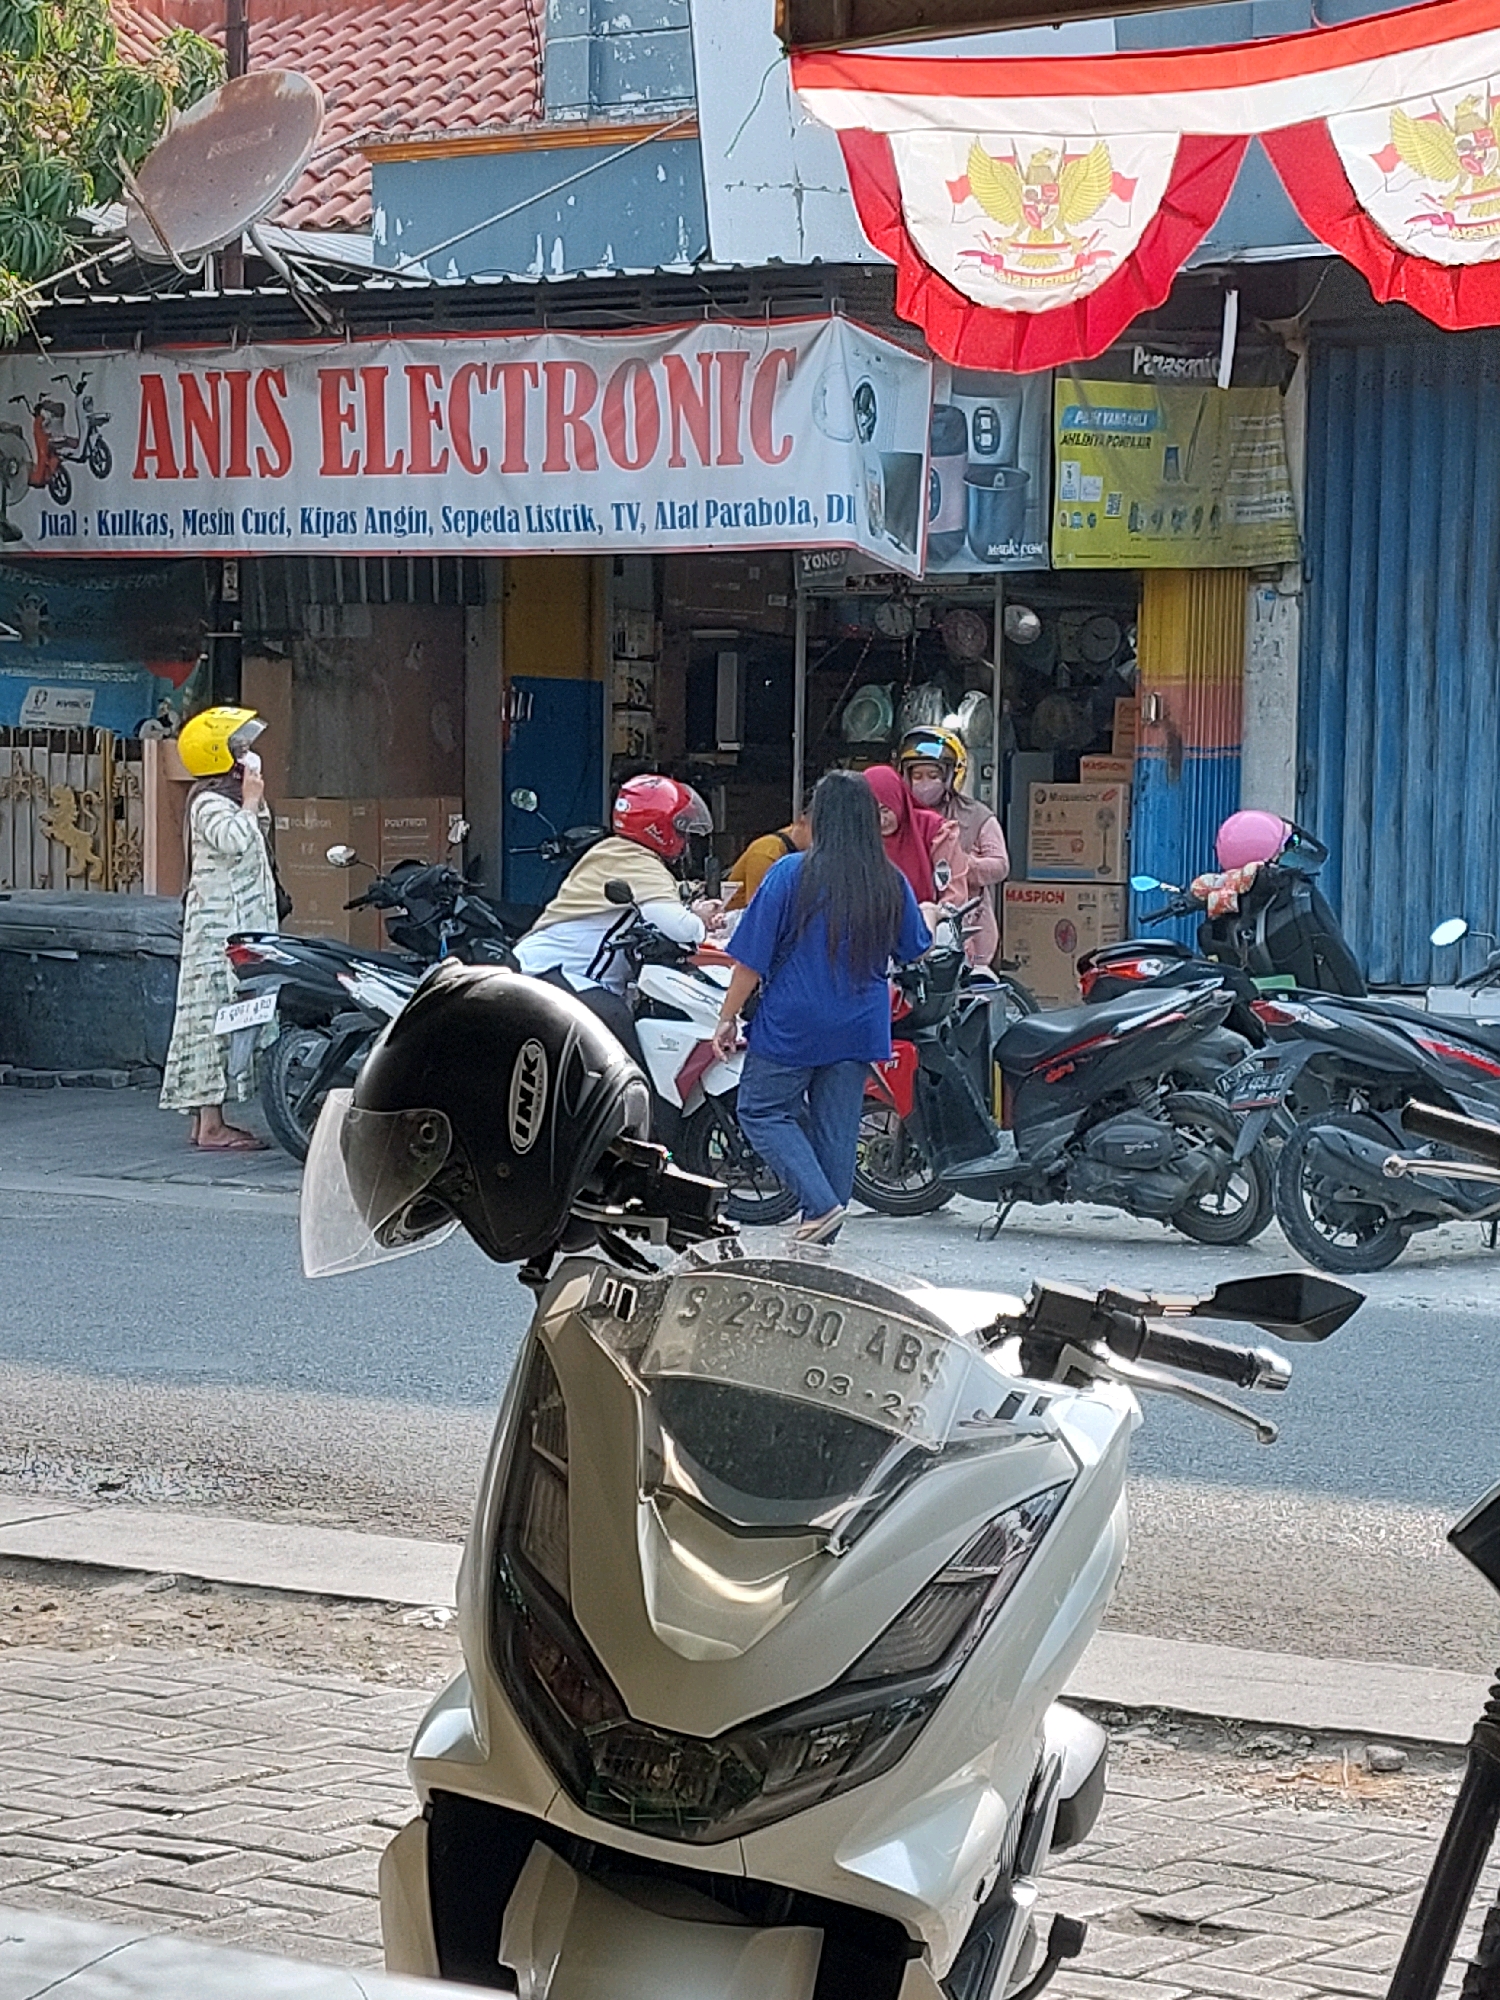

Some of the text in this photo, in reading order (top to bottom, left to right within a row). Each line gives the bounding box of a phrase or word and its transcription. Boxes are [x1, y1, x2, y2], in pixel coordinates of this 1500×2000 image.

[132, 346, 798, 480] ANIS ELECTRONIC
[38, 509, 78, 541] Jual
[96, 508, 175, 540] Kulkas,
[181, 506, 236, 537] Mesin
[240, 505, 293, 538] Cuci,
[299, 506, 358, 538] Kipas
[364, 505, 434, 538] Angin,
[441, 503, 521, 538] Sepeda
[525, 501, 604, 536] Listrik,
[611, 501, 646, 535] TV,
[654, 499, 700, 530] Alat
[704, 496, 820, 530] Parabola,
[1005, 888, 1066, 904] MASPION
[514, 1050, 540, 1142] INK
[677, 1286, 708, 1328] S
[722, 1290, 846, 1350] 2990
